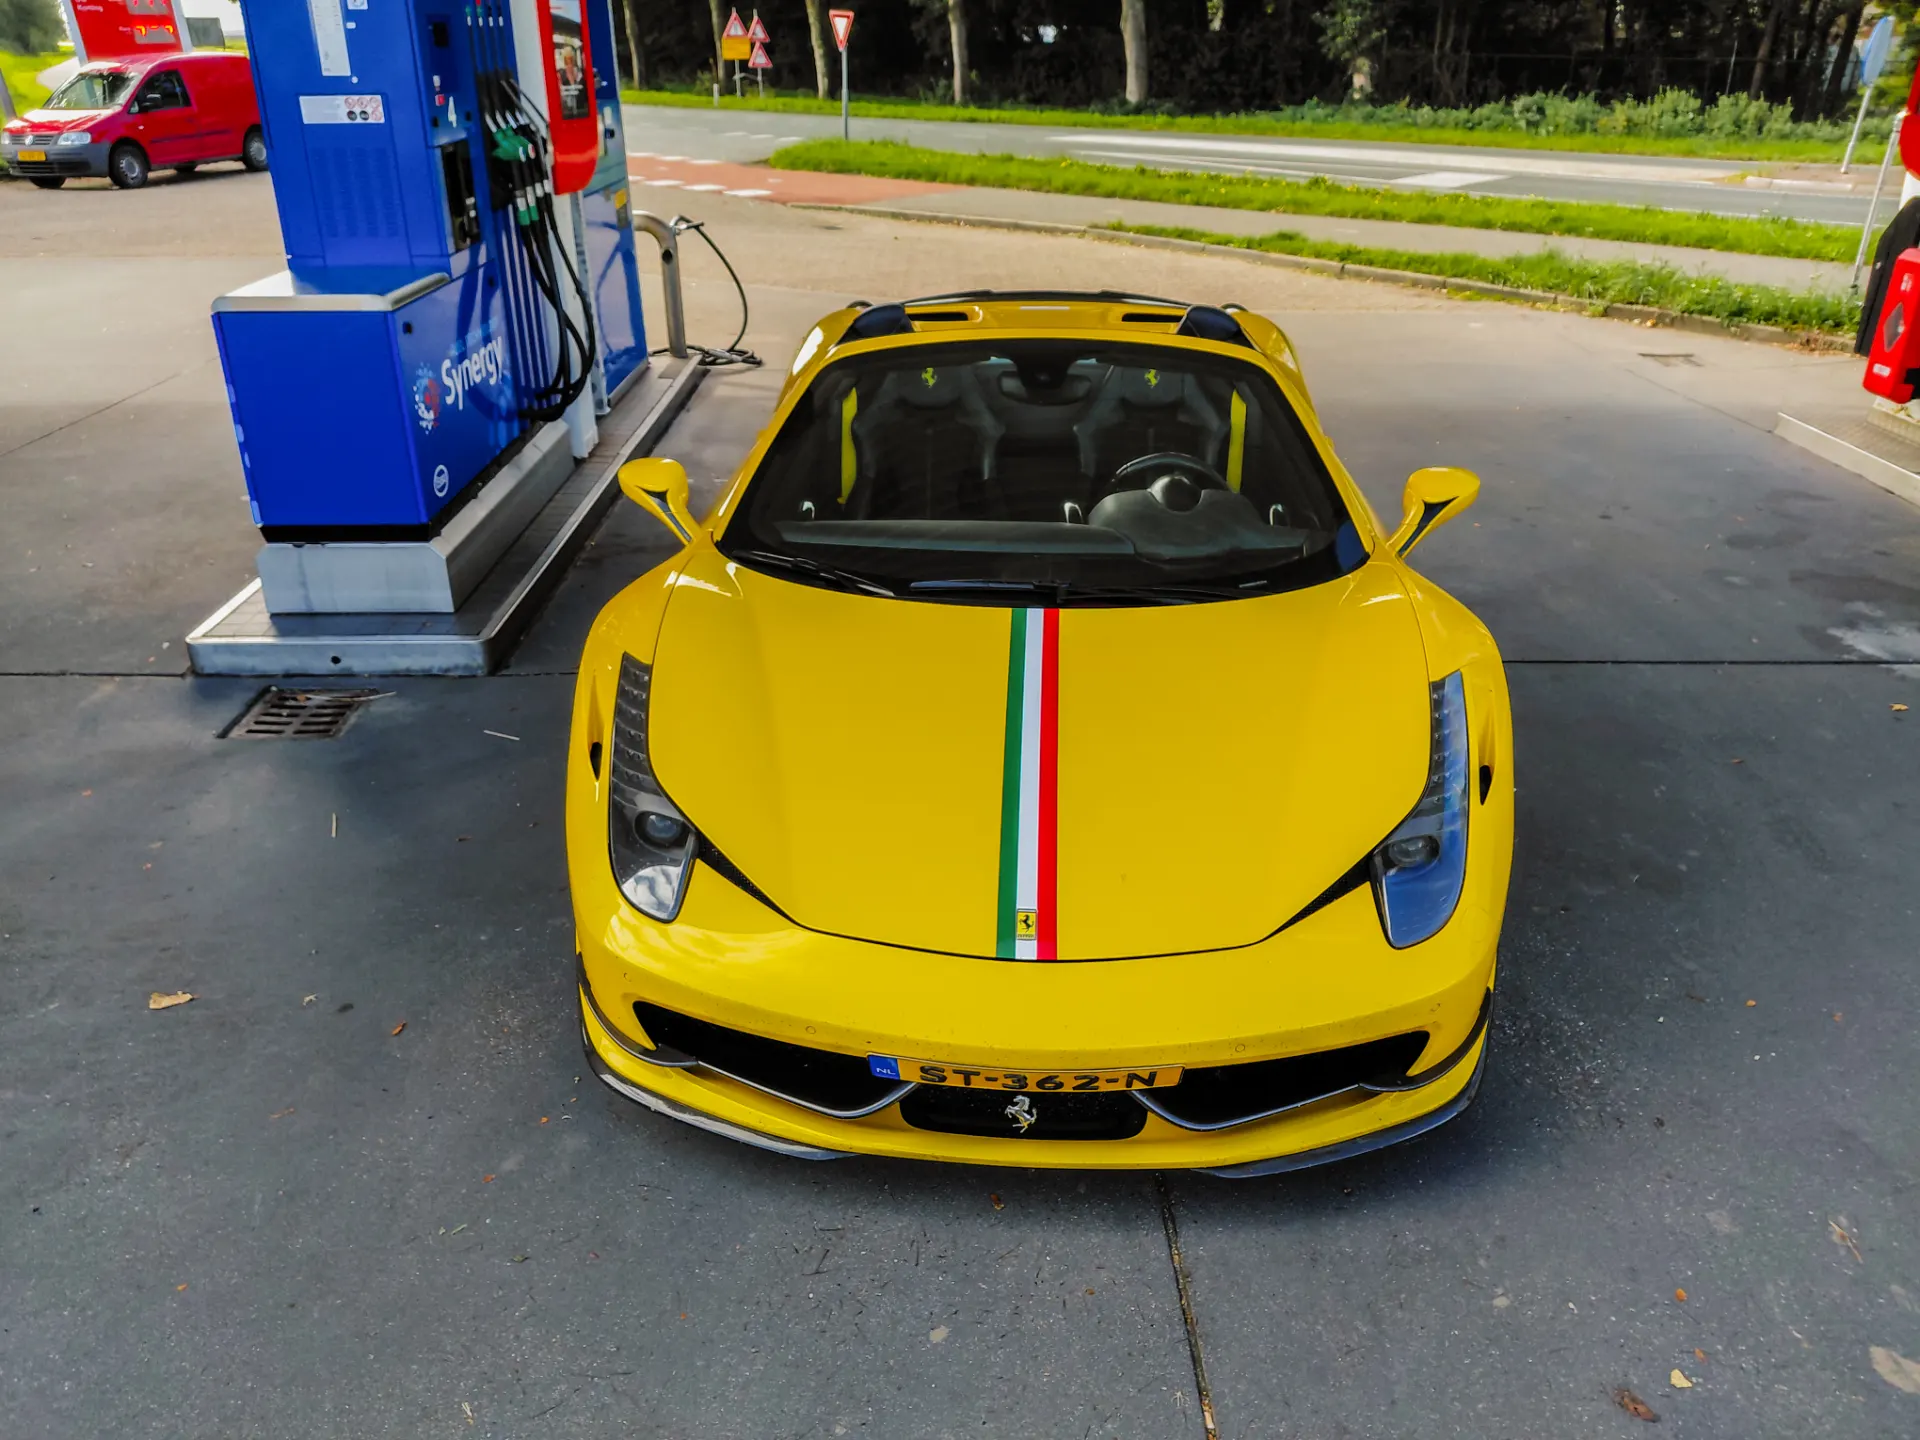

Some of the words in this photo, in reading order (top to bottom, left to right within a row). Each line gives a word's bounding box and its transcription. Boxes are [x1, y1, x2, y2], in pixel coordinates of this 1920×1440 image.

[441, 335, 503, 411] Synergy
[876, 1067, 896, 1075] NL
[919, 1065, 1158, 1091] ST-362-N
